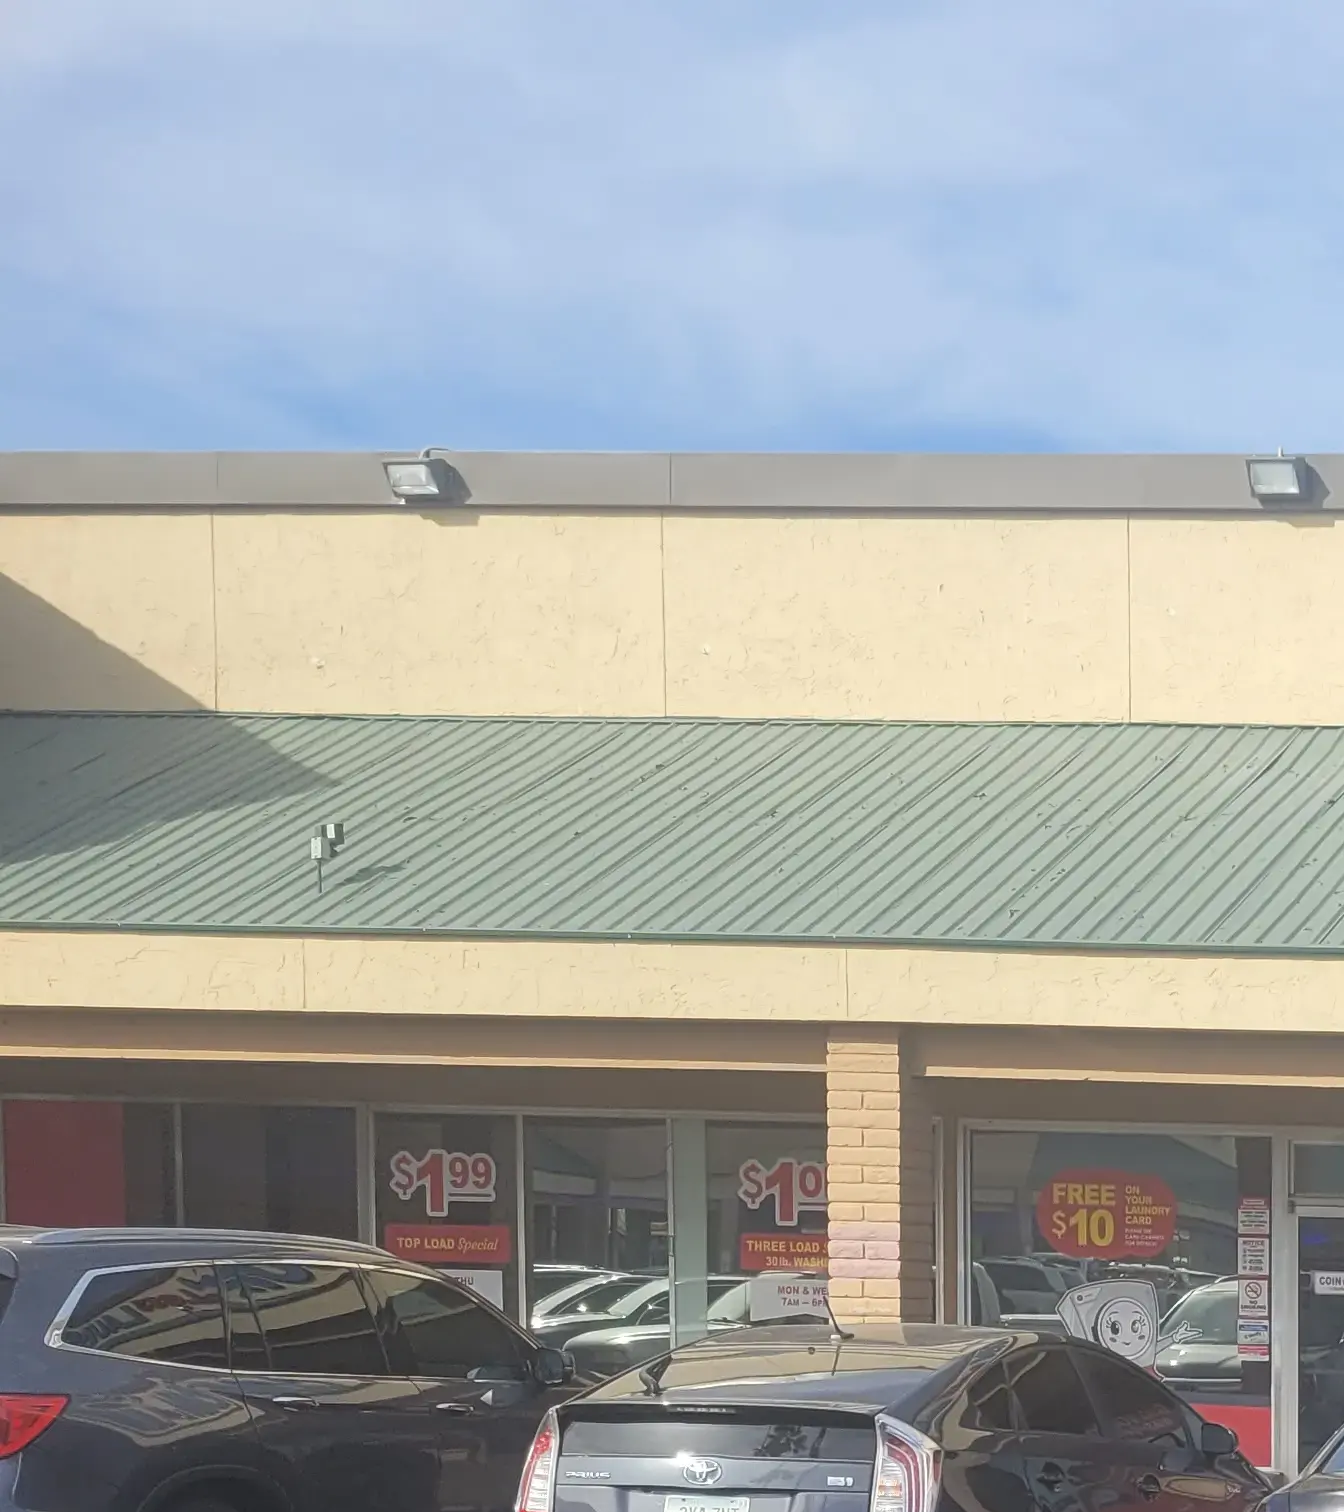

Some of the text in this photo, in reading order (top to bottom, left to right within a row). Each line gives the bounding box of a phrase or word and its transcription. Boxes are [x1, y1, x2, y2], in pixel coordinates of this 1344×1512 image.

[1052, 1183, 1116, 1206] FREE
[1125, 1185, 1140, 1195] ON
[1125, 1195, 1153, 1205] YOUR
[1125, 1205, 1172, 1216] LAUNDRY
[1125, 1216, 1152, 1225] CARD
[1052, 1208, 1115, 1247] $10
[397, 1237, 499, 1254] TOP LOAD Special
[746, 1240, 786, 1253] THREE
[789, 1242, 820, 1253] LOAD
[793, 1257, 828, 1268] WASH
[1319, 1276, 1341, 1286] COIN
[777, 1285, 829, 1296] MON & WE
[781, 1297, 800, 1307] 7AM
[565, 1471, 611, 1479] PRIUS
